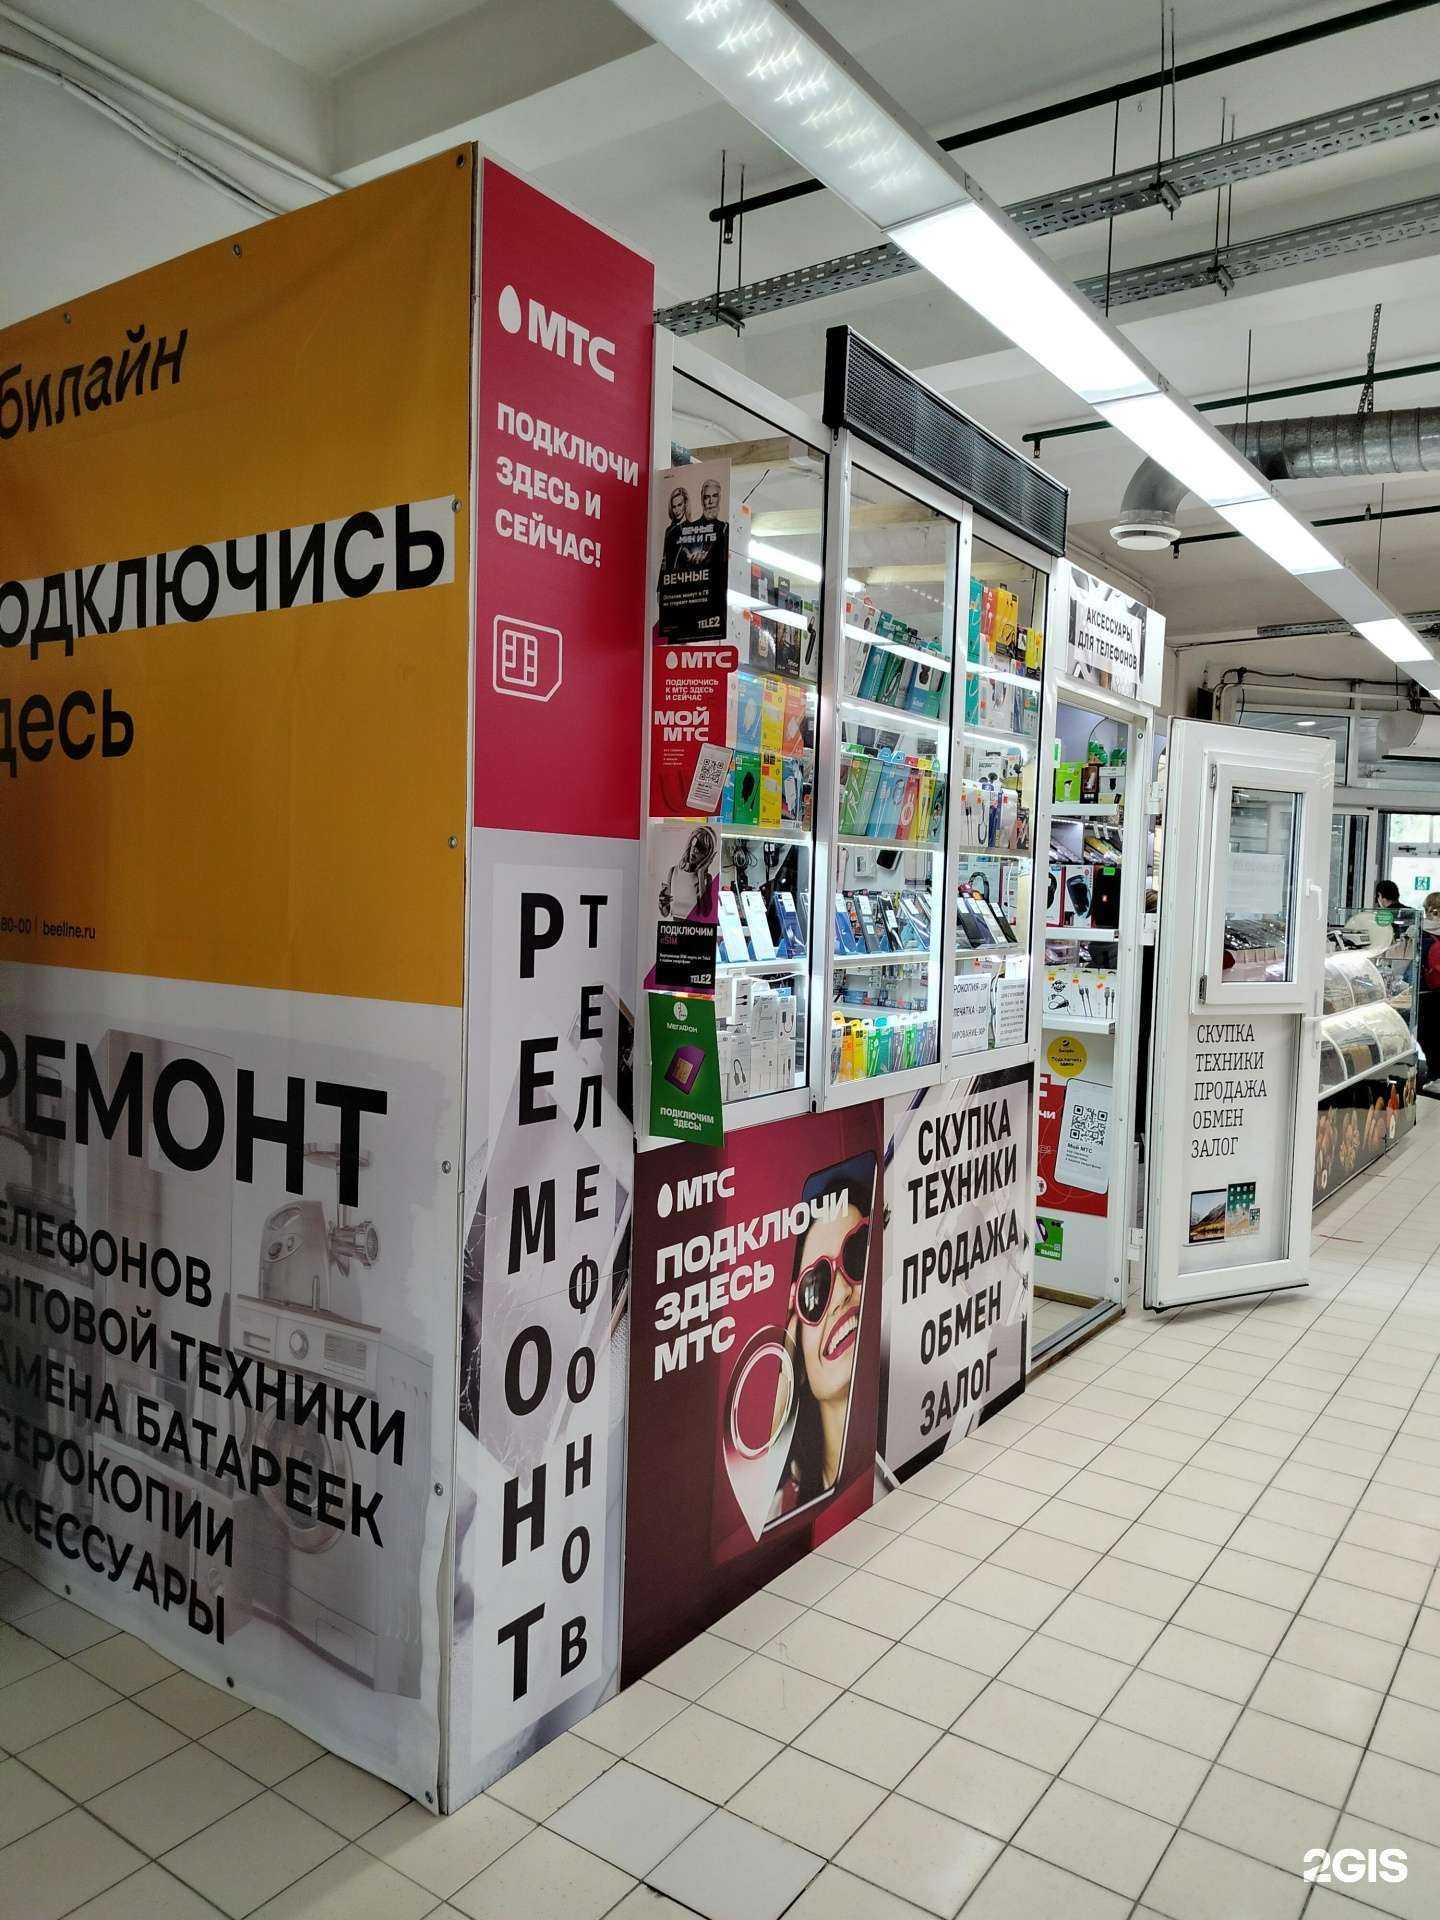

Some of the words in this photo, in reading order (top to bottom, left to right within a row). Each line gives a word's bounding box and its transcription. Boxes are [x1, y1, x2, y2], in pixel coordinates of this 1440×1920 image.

[529, 298, 616, 382] МТС
[0, 325, 188, 439] билайн
[497, 402, 639, 487] ПОДКЛЮЧИ
[496, 456, 580, 510] ЗДЕСЬ
[585, 489, 601, 520] И
[495, 508, 601, 568] СЕЙЧАС!
[663, 569, 709, 585] ВЕЧНЫЕ
[698, 616, 720, 628] TELE2
[1087, 607, 1133, 643] АКСЕССУАРЫ
[682, 651, 732, 669] МТС
[1077, 631, 1094, 653] ДЛЯ
[1095, 638, 1138, 670] ТЕЛЕФОНОВ
[665, 679, 719, 687] ПОДКЛЮЧИСЬ
[672, 693, 702, 701] СЕЙЧАС
[690, 686, 714, 694] ЗДЕСЬ
[654, 706, 710, 725] МОЙ
[663, 727, 709, 742] МТС
[43, 920, 96, 939] beeline.ru
[660, 925, 714, 937] ПОДКЛЮЧИМ
[690, 974, 712, 985] TELE2
[1197, 1024, 1255, 1043] СКУПКА
[1195, 1051, 1265, 1072] ТЕХНИКИ
[1194, 1079, 1267, 1104] ПРОДАЖА
[660, 1107, 714, 1124] ПОДКЛЮЧИМ
[917, 1098, 1012, 1166] СКУПКА
[1192, 1109, 1244, 1130] ОБМЕН
[1191, 1137, 1239, 1159] ЗАЛОГ
[677, 1167, 735, 1212] МТС
[908, 1144, 1017, 1225] ТЕХНИКИ
[656, 1188, 849, 1286] ПОДКЛЮЧИ
[901, 1208, 1020, 1305] ПРОДАЖА
[654, 1261, 776, 1332] ЗДЕСЬ
[920, 1280, 1002, 1366] ОБМЕН
[654, 1316, 737, 1382] МТС
[0, 1276, 157, 1371] ЫТОВОЙ
[171, 1330, 407, 1467] ТЕХНИКИ
[920, 1349, 998, 1437] ЗАЛОГ
[136, 1400, 385, 1548] БАТАРЕЕК
